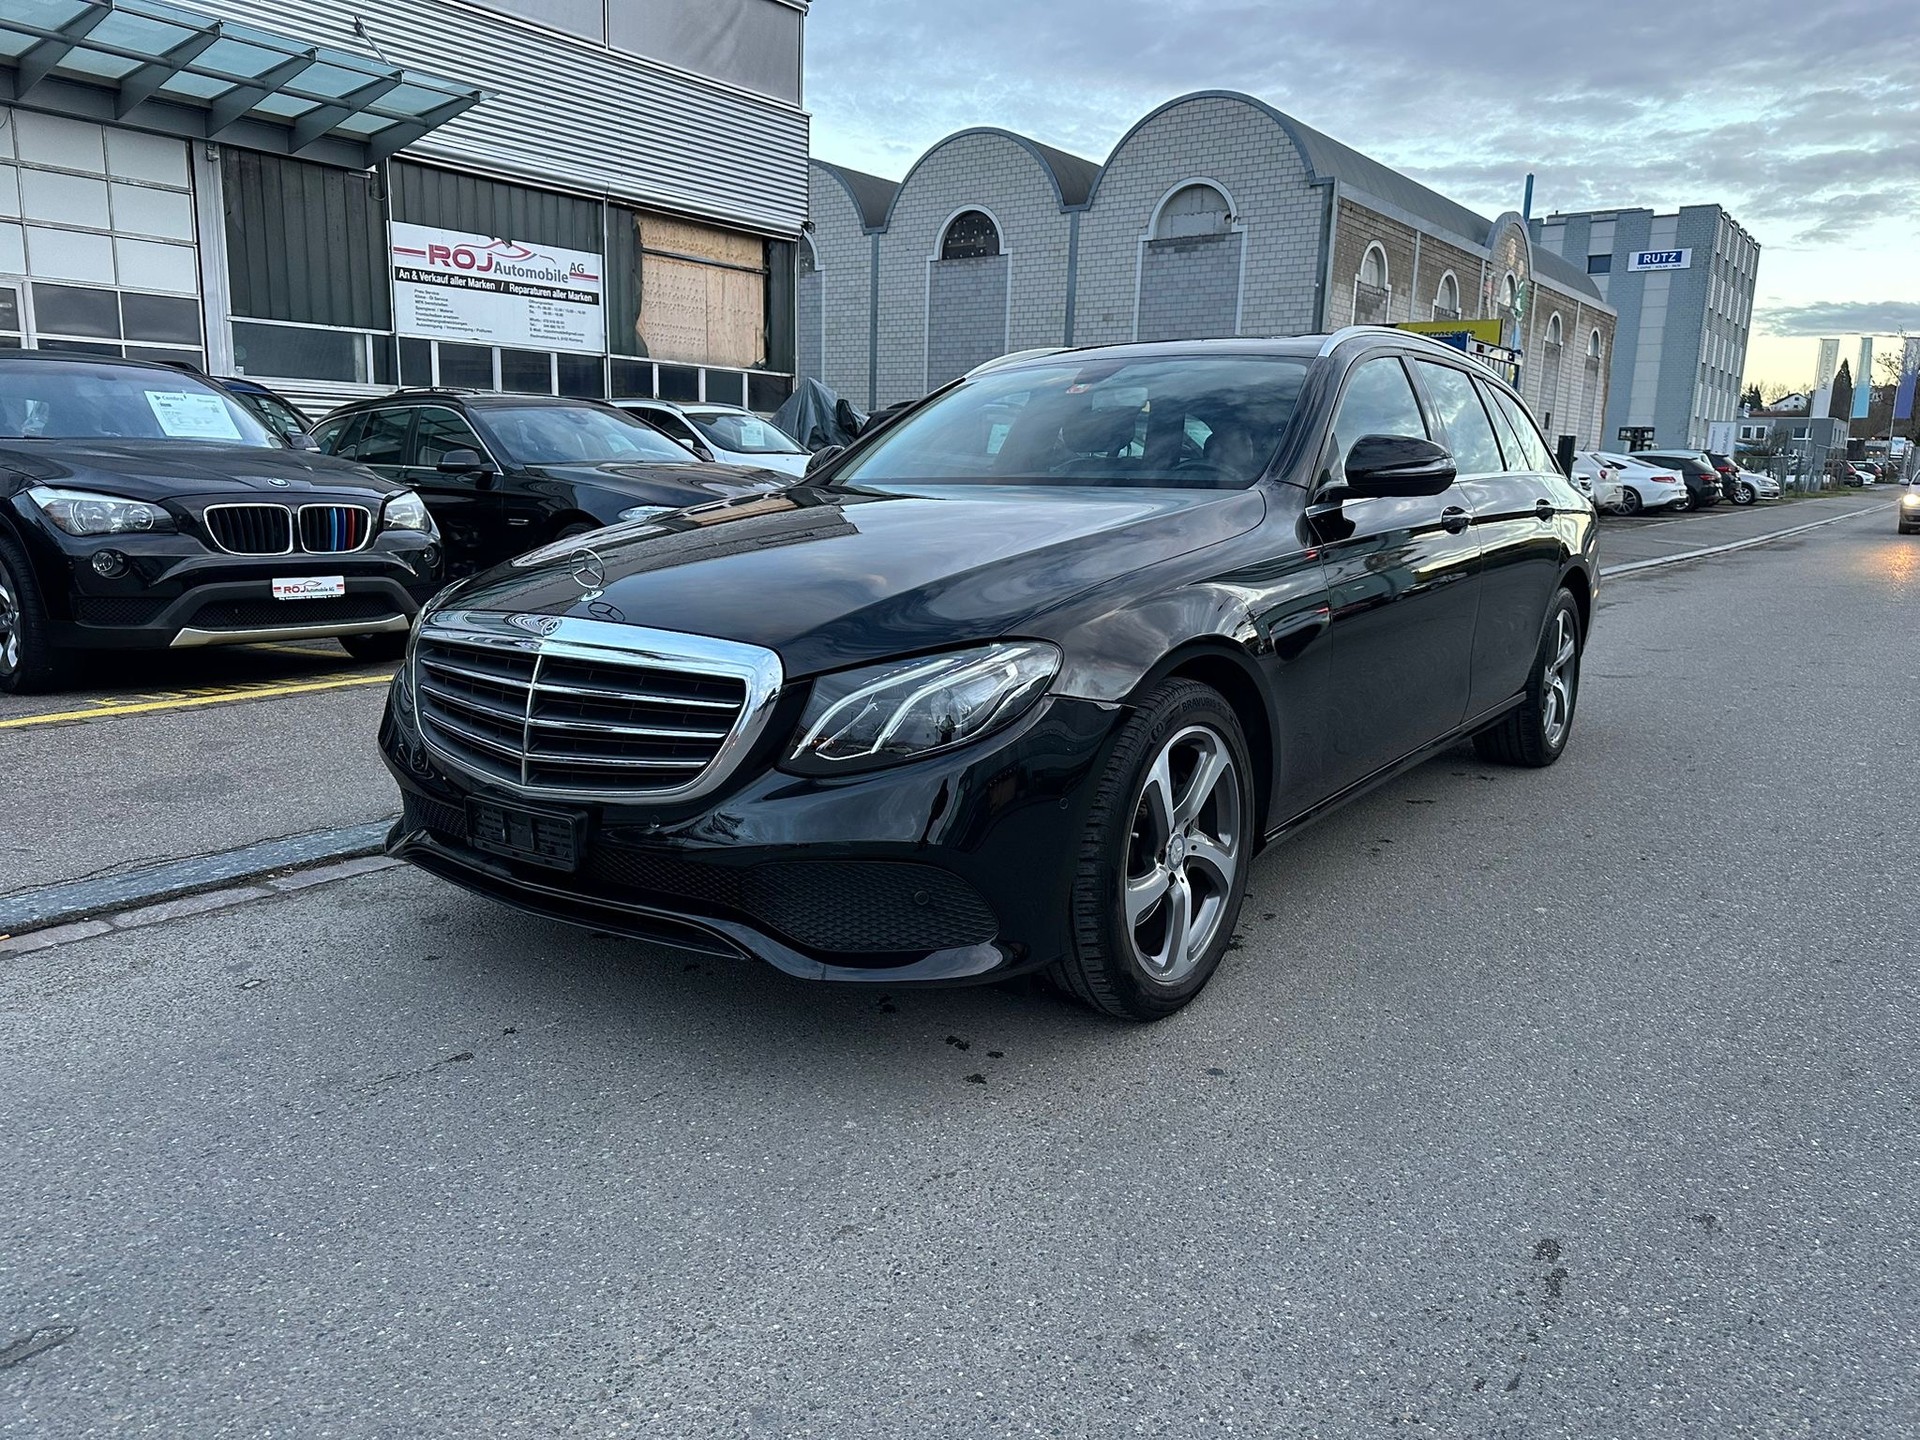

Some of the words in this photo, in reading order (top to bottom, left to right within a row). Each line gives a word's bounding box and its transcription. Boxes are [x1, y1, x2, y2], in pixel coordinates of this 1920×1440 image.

[428, 244, 493, 272] ROJ
[493, 261, 569, 283] Automobile
[569, 262, 585, 274] AG
[1643, 252, 1677, 263] RUTZ
[398, 268, 410, 279] An
[411, 270, 418, 280] &
[419, 271, 449, 285] Verkauf
[450, 276, 466, 287] aller
[467, 278, 496, 290] Marken
[509, 284, 552, 297] Reparaturen
[552, 290, 567, 299] aller
[567, 290, 593, 302] Marken
[283, 585, 306, 594] ROJ
